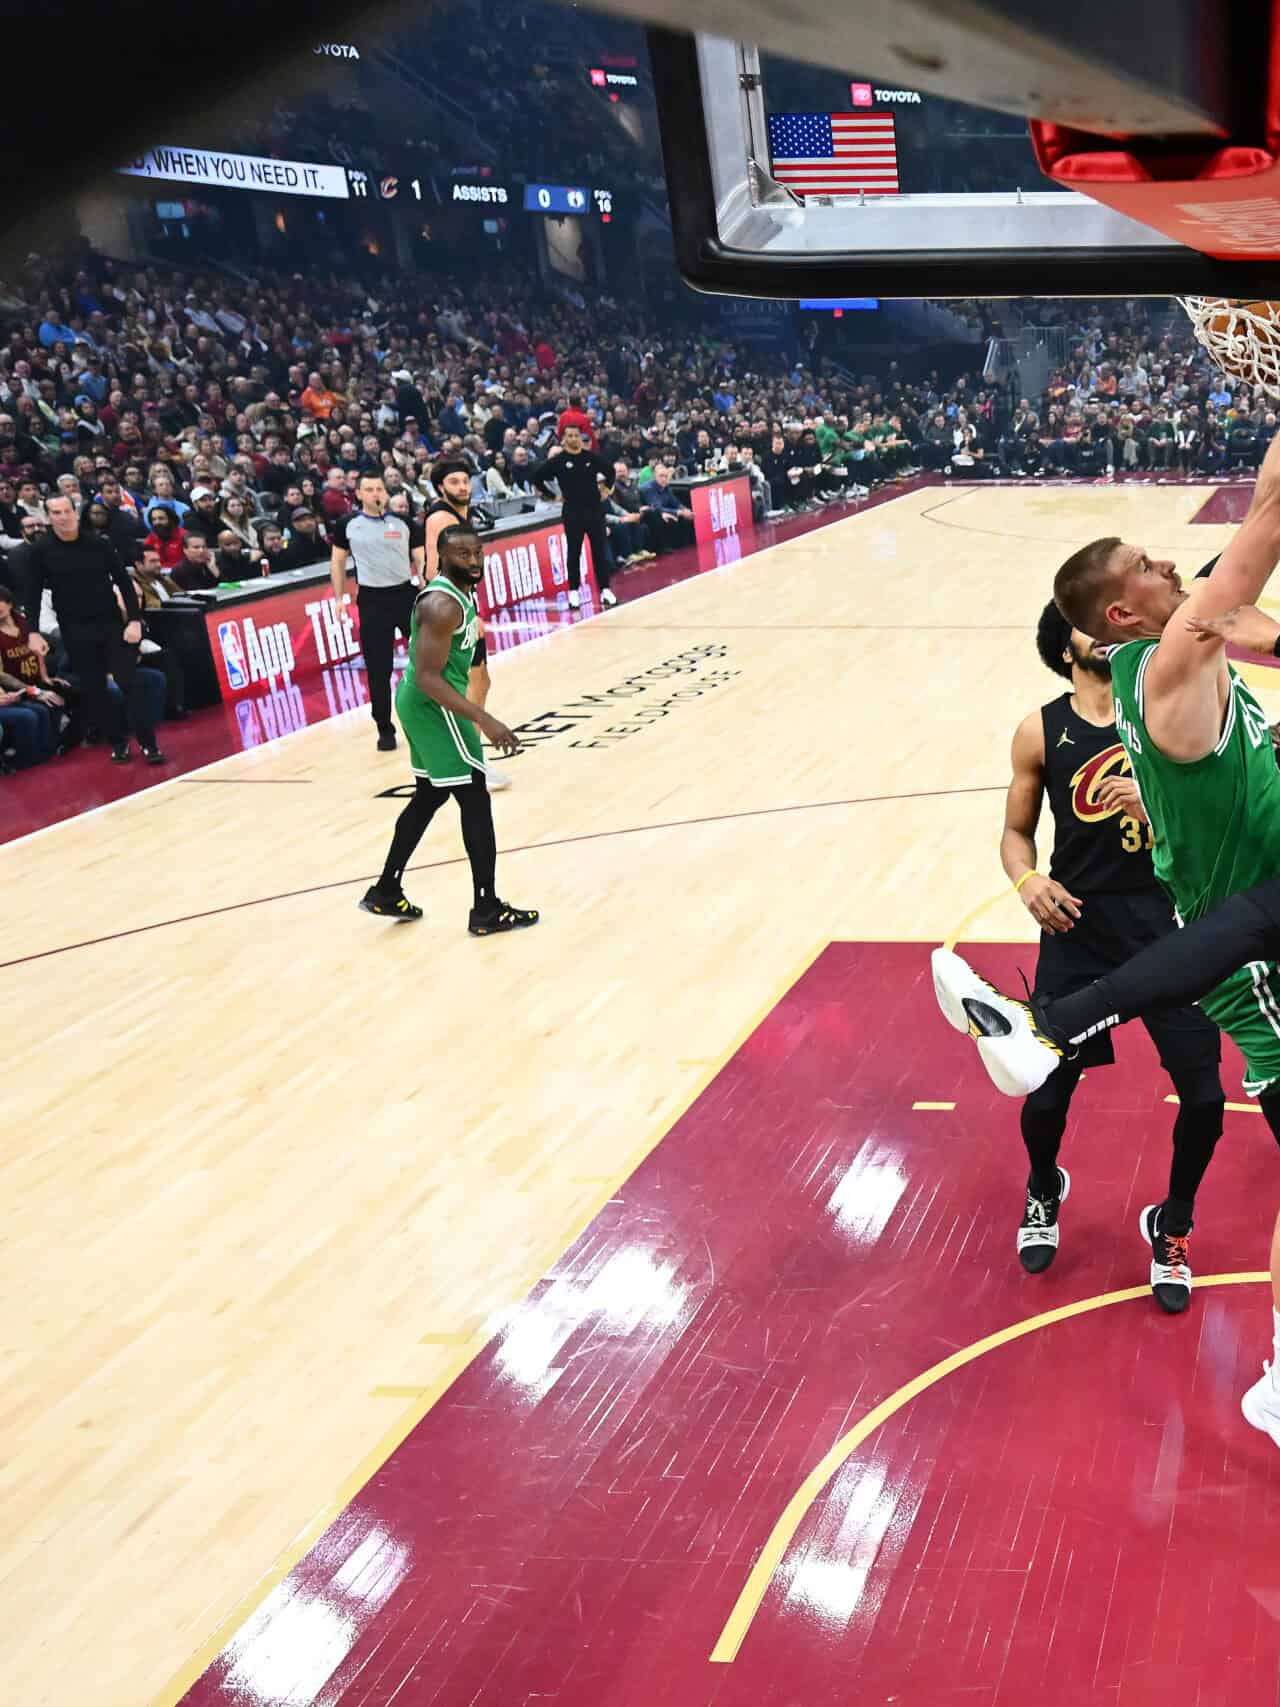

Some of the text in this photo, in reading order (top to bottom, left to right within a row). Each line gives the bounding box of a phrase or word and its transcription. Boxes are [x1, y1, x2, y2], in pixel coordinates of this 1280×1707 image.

[874, 89, 921, 104] TOYOTA
[153, 150, 208, 177] WHEN
[210, 157, 246, 182] YOU
[251, 164, 298, 188] NEED
[303, 169, 325, 190] IT.
[352, 181, 367, 197] 11
[411, 180, 422, 200] 1
[453, 184, 508, 203] ASSISTS
[538, 189, 550, 208] 0
[505, 543, 544, 601] NBA
[242, 617, 296, 684] App
